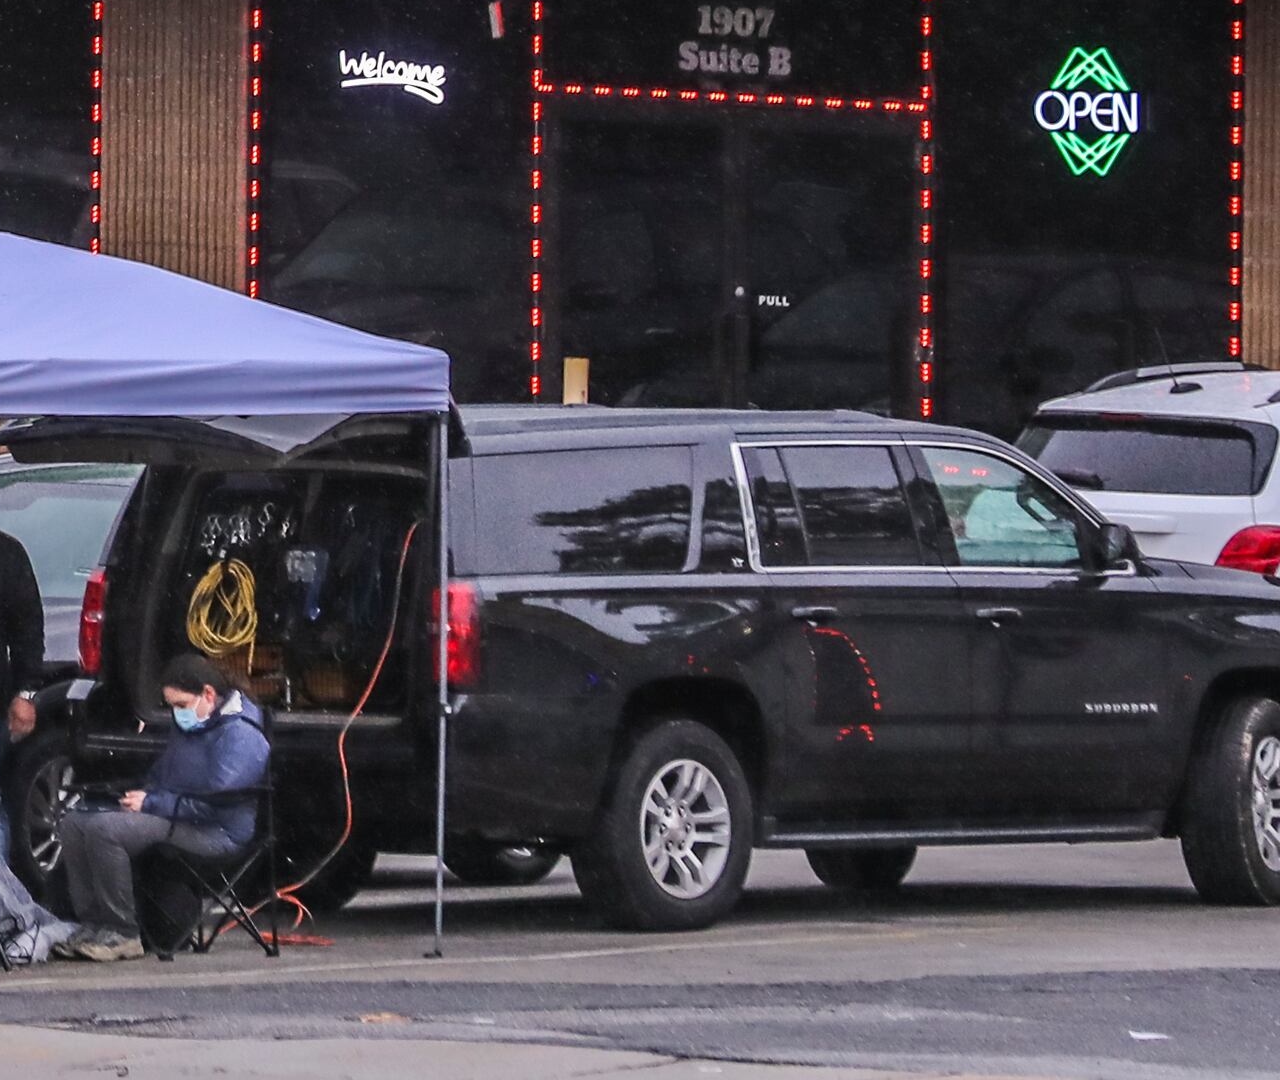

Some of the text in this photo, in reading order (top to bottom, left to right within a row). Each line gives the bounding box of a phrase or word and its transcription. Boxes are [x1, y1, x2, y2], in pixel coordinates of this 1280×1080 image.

[697, 4, 775, 38] 1907
[339, 49, 447, 89] Welcome
[678, 41, 792, 76] Suite B
[1035, 90, 1139, 133] OPEN
[758, 294, 791, 307] PULL
